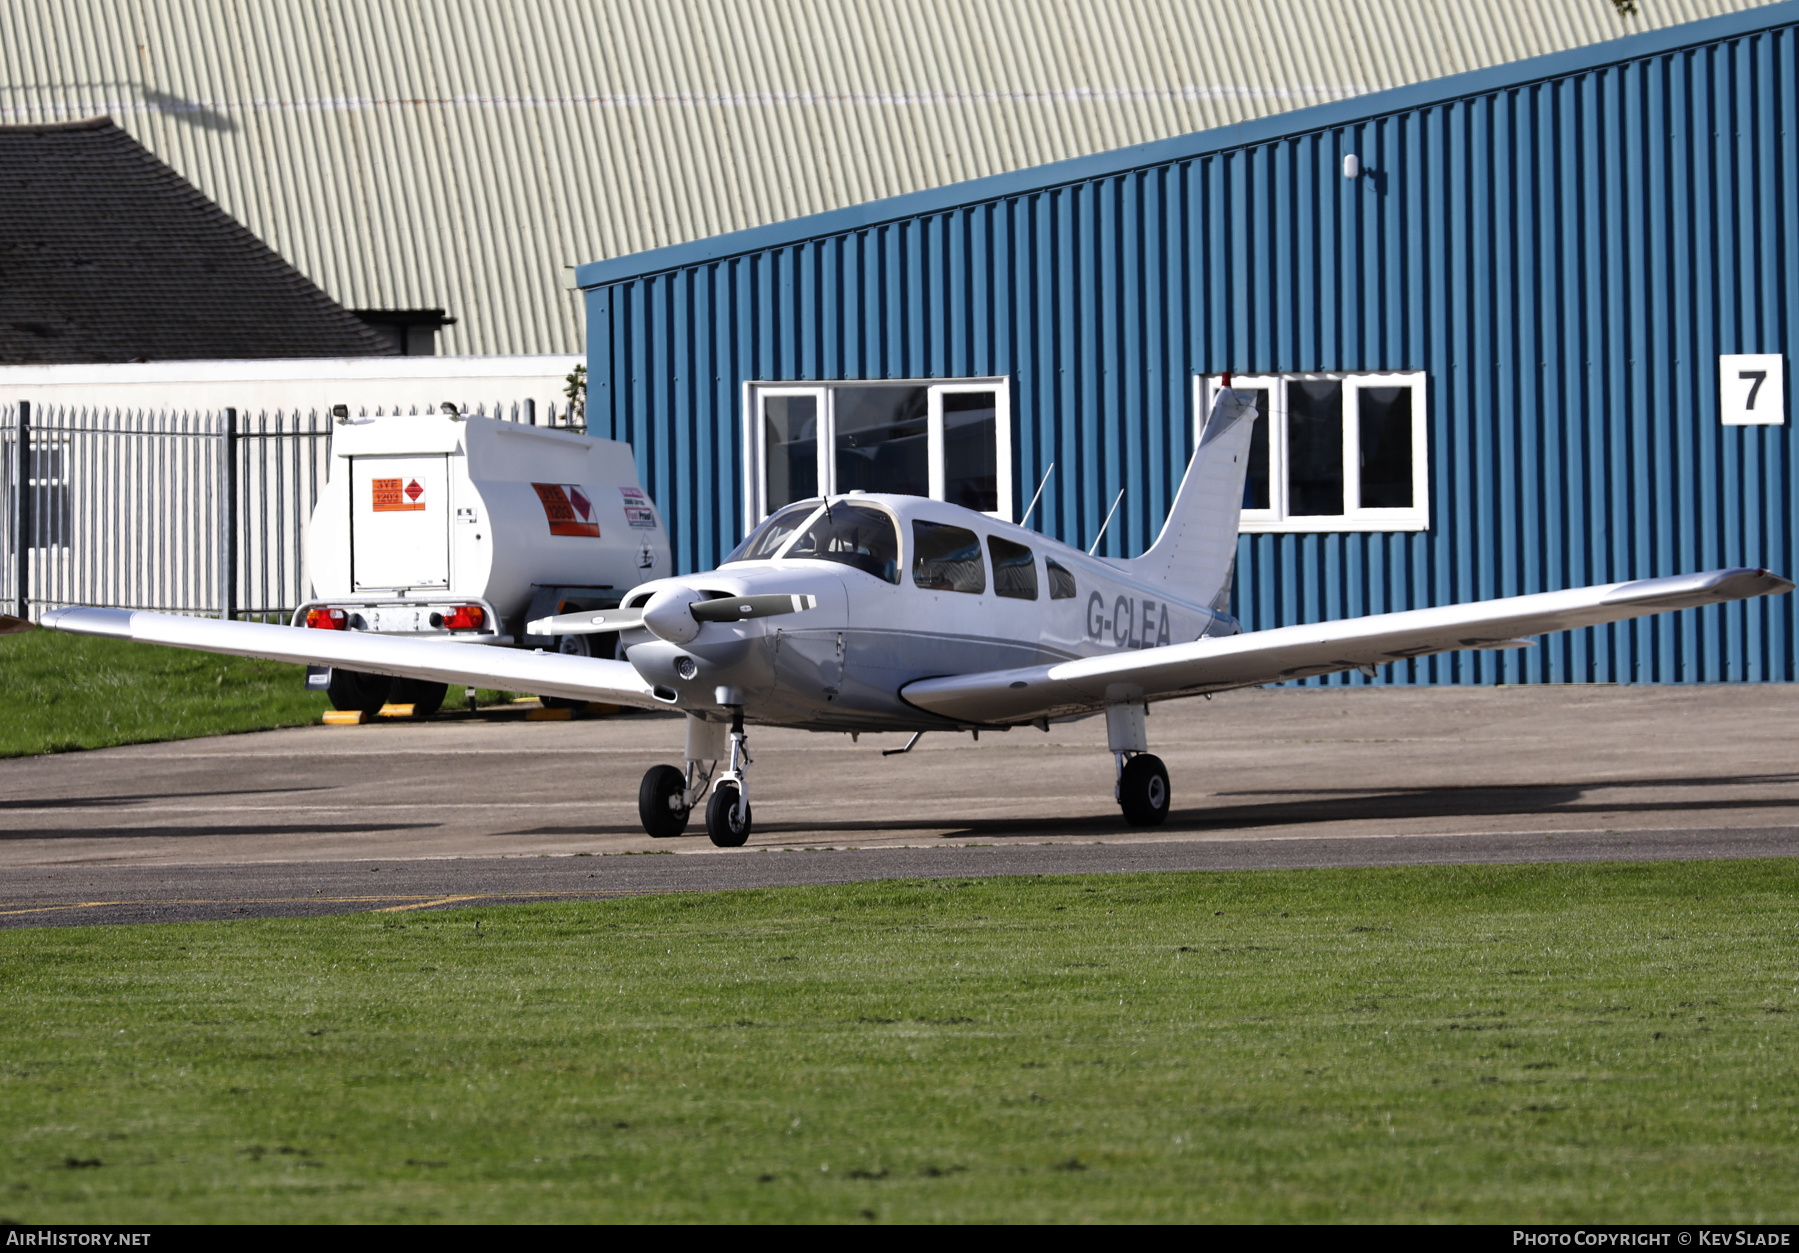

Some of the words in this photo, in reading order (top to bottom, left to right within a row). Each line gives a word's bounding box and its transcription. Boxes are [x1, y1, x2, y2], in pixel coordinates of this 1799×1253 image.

[1738, 370, 1767, 411] 7
[376, 491, 399, 503] 1203
[1086, 589, 1171, 650] G-CLEA
